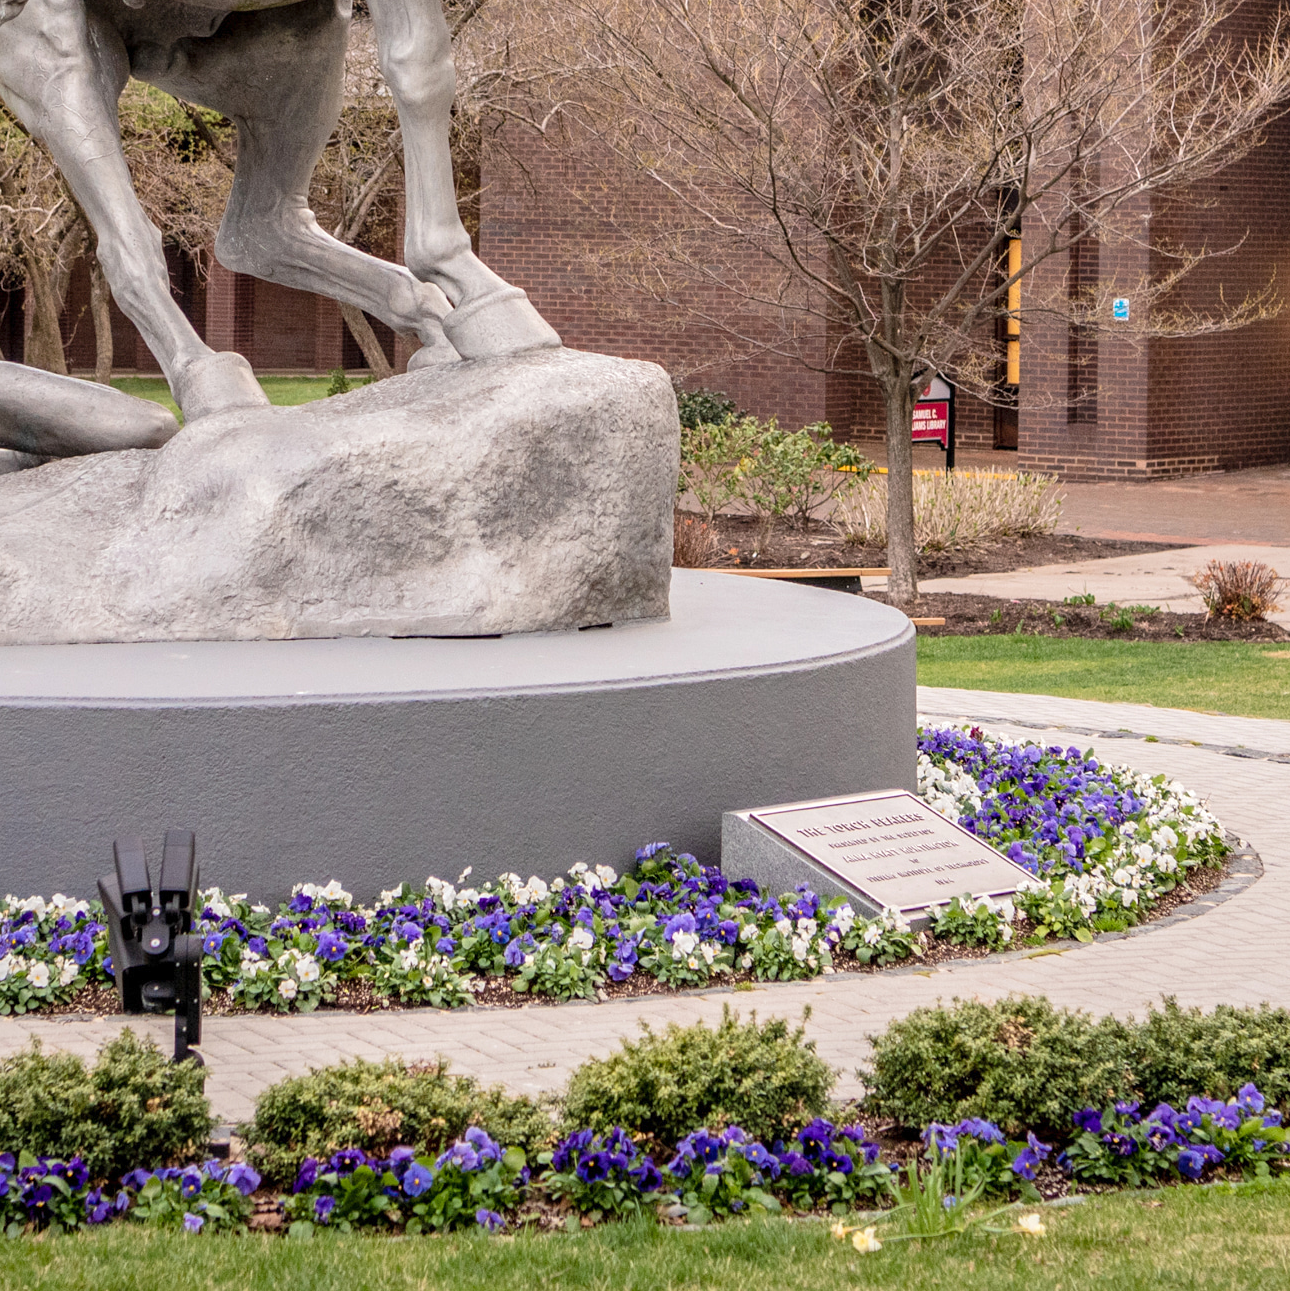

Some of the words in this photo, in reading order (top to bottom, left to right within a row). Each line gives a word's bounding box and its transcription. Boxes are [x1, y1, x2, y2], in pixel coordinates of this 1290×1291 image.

[912, 409, 931, 420] SAMUEL
[926, 419, 947, 430] LIBRARY
[796, 825, 827, 838] THE
[823, 819, 872, 834] TORCH
[869, 812, 926, 827] BEARERS
